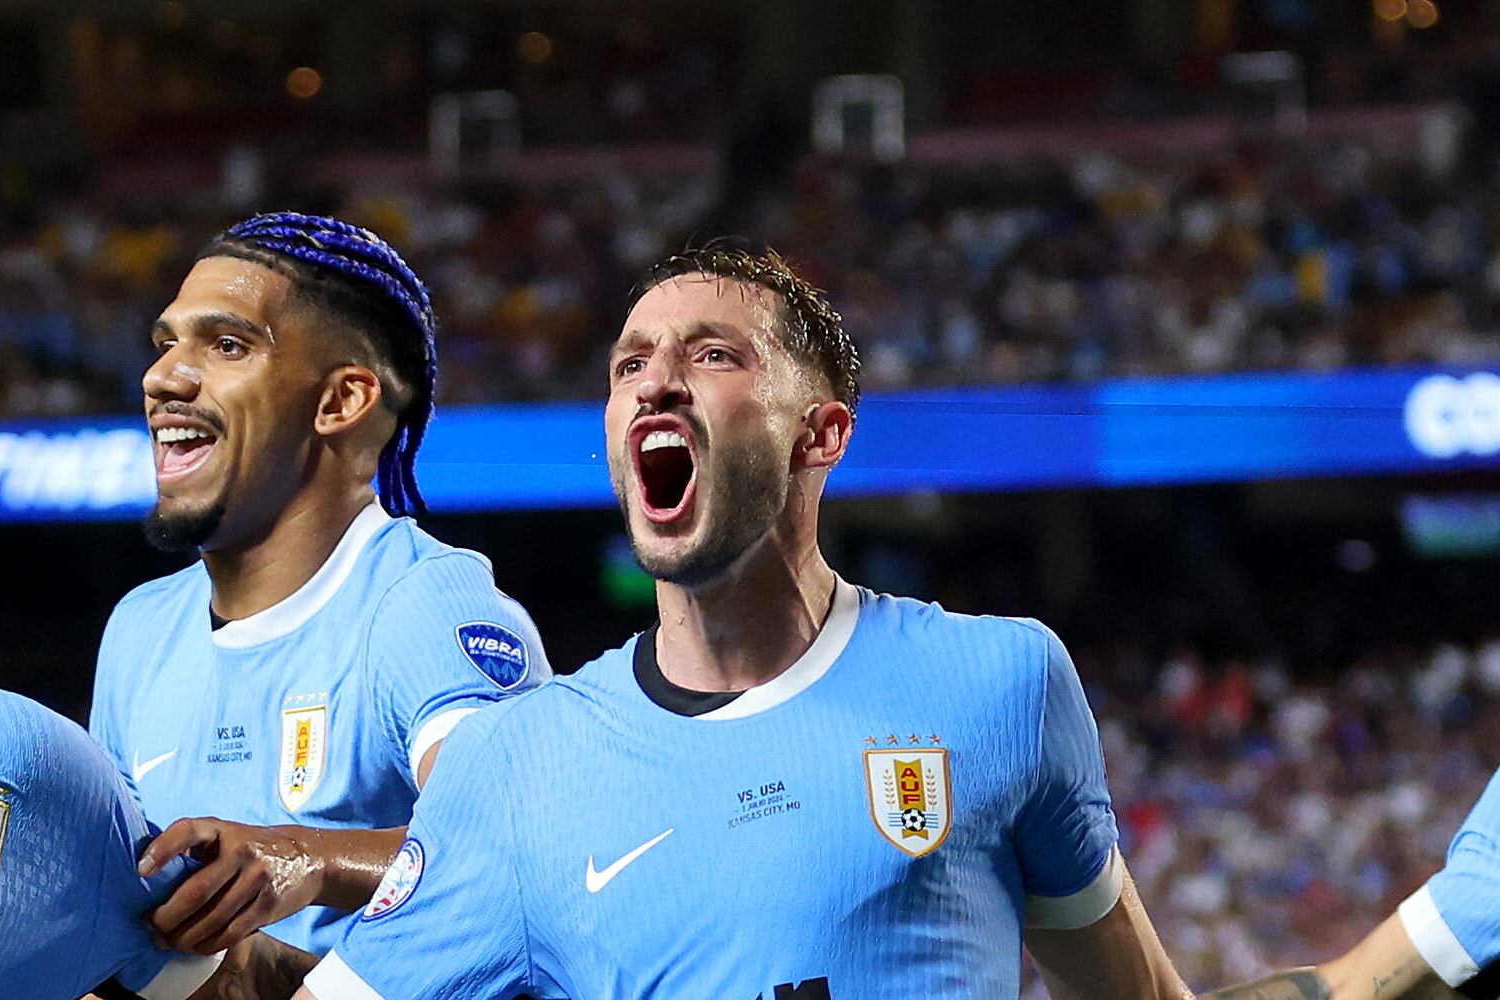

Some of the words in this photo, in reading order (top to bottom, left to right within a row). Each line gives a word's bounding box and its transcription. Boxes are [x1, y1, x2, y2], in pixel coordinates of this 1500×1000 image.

[468, 636, 522, 660] VIBRA
[296, 726, 308, 763] AUF
[737, 789, 757, 803] VS.
[760, 780, 785, 797] USA
[900, 767, 921, 805] AUF
[728, 809, 762, 829] KANSAS
[786, 800, 801, 811] MO
